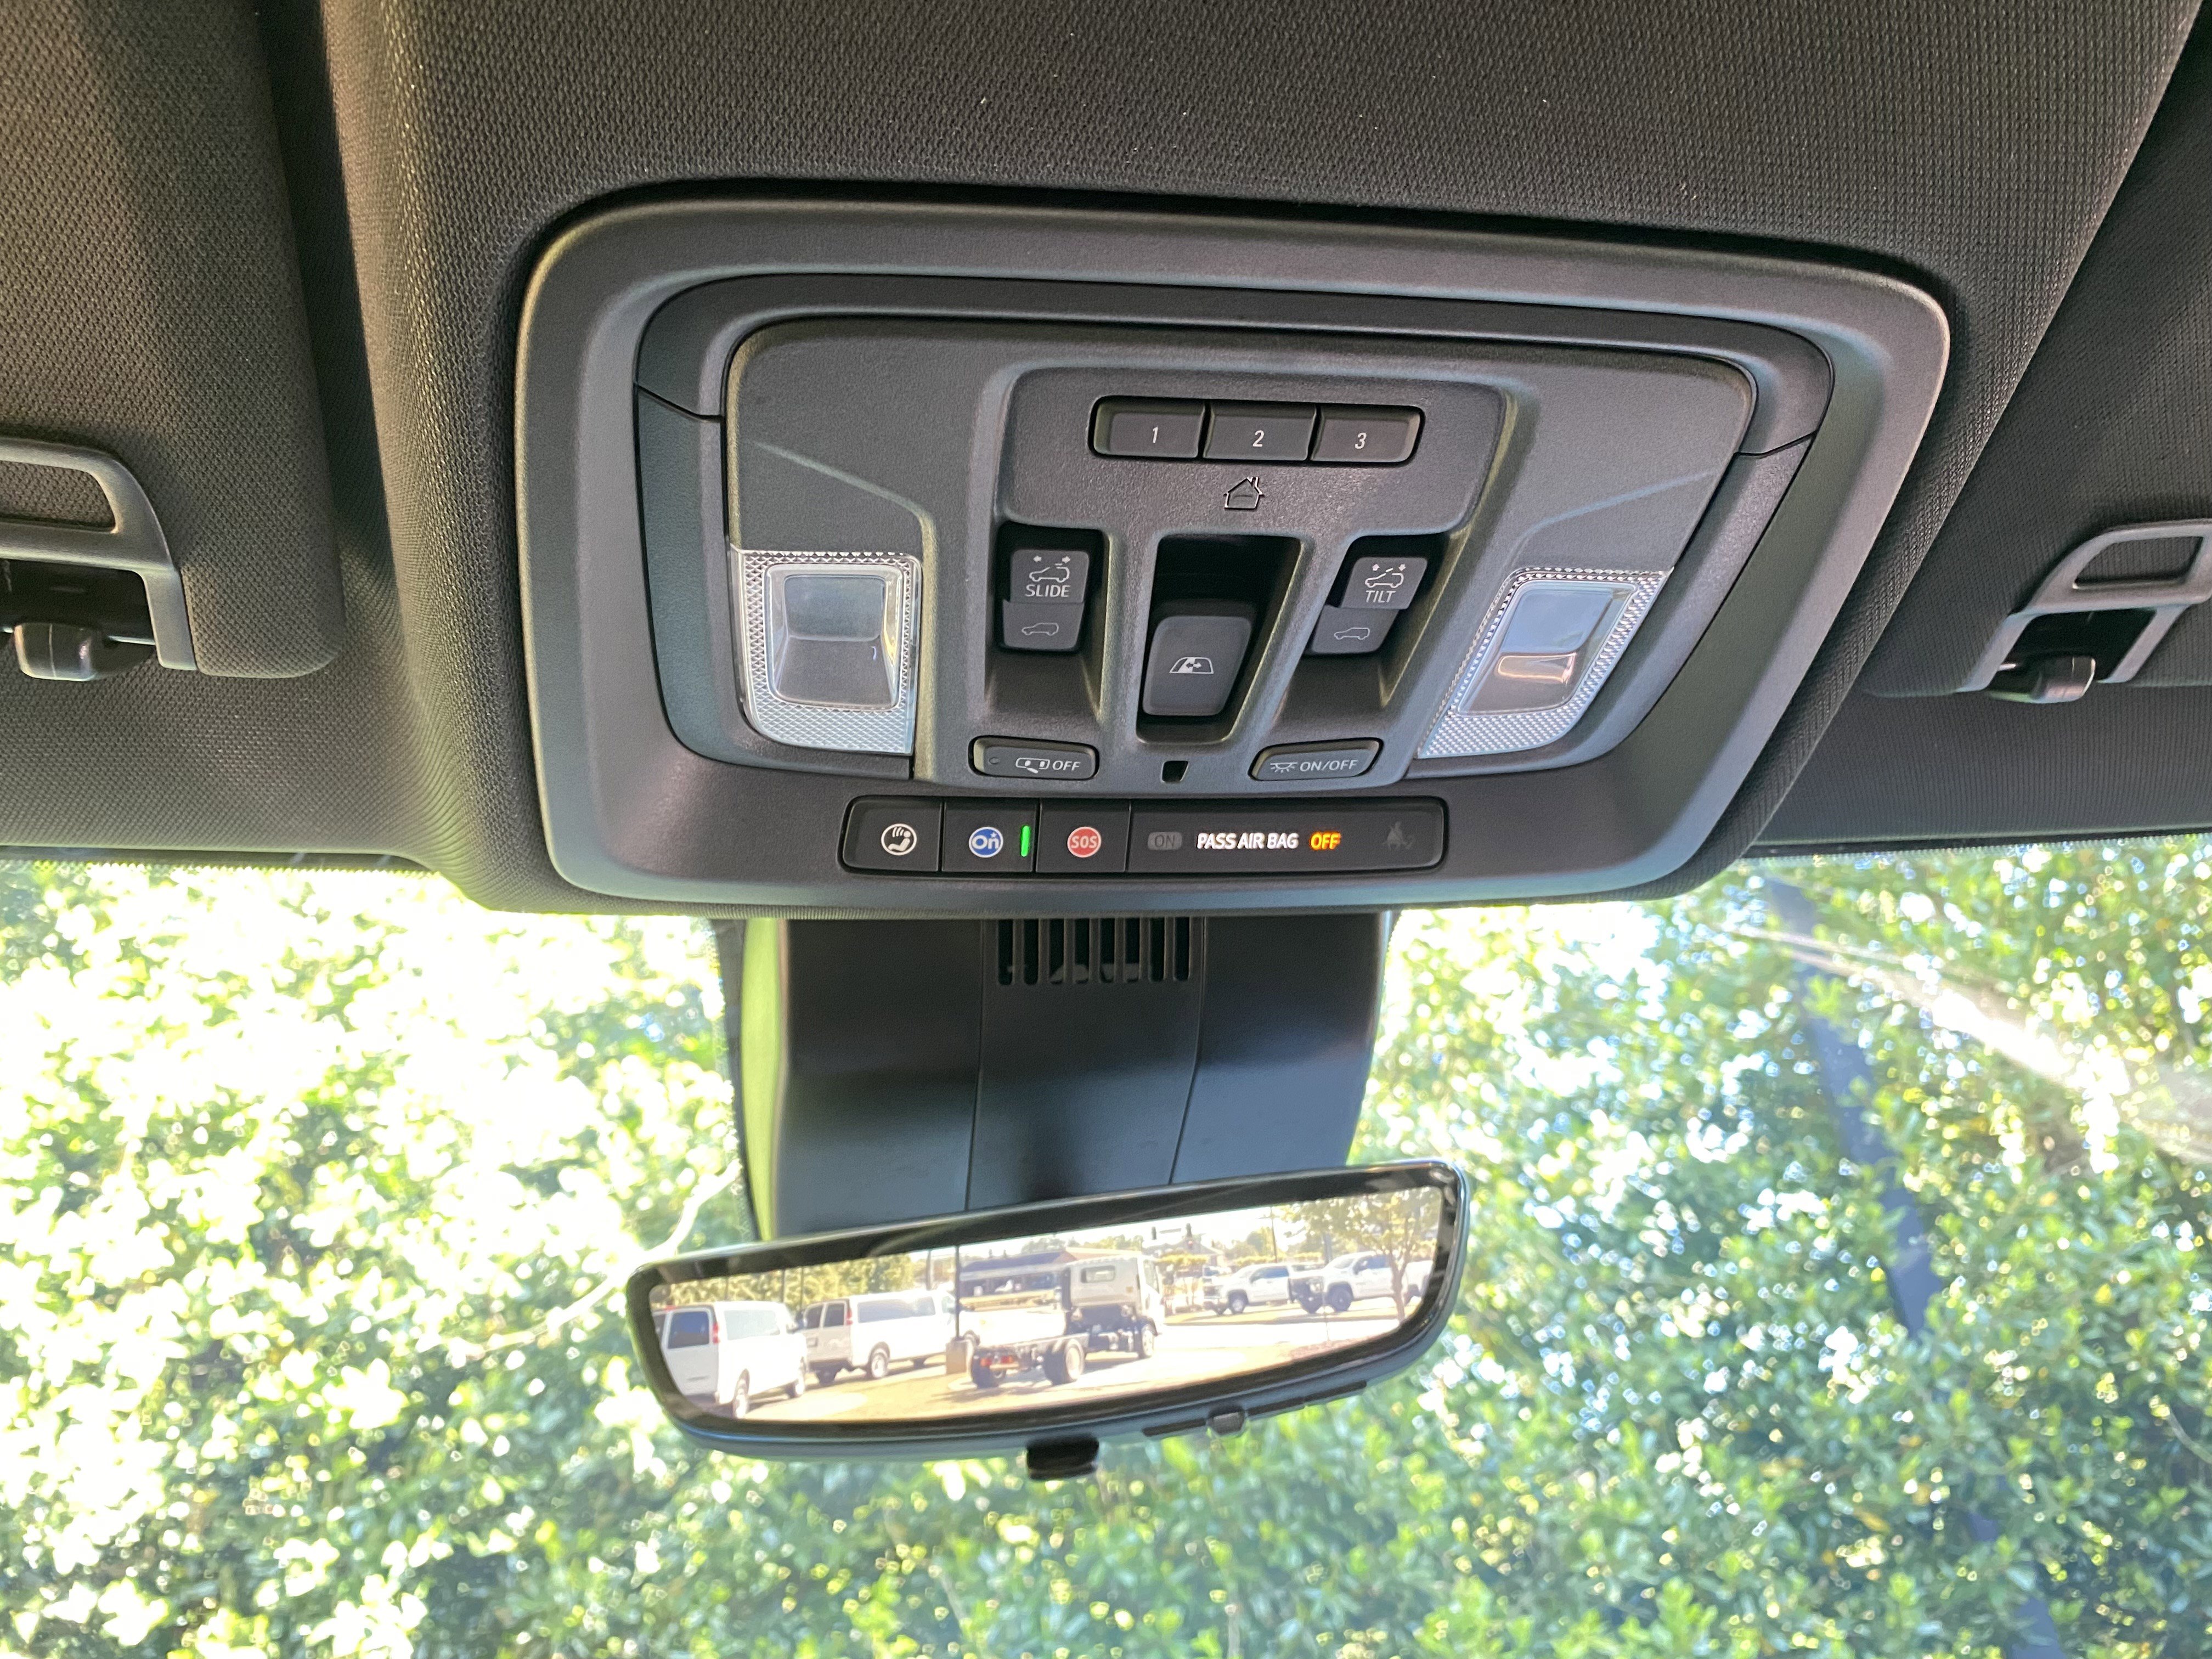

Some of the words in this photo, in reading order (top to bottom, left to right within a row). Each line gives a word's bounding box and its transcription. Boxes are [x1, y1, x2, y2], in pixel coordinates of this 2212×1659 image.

[1152, 427, 1158, 444] 1
[1252, 430, 1265, 447] 2
[1355, 432, 1367, 449] 3
[1025, 584, 1071, 597] SLIDE
[1365, 590, 1396, 603] TILT
[1052, 760, 1081, 771] OFF
[1300, 759, 1358, 772] ON/OFF
[972, 834, 1000, 850] On
[1071, 836, 1097, 849] SOS
[1154, 834, 1175, 849] ON
[1197, 832, 1237, 850] PASS
[1237, 832, 1266, 849] AIR
[1267, 832, 1300, 850] BAG
[1310, 831, 1341, 850] OFF
